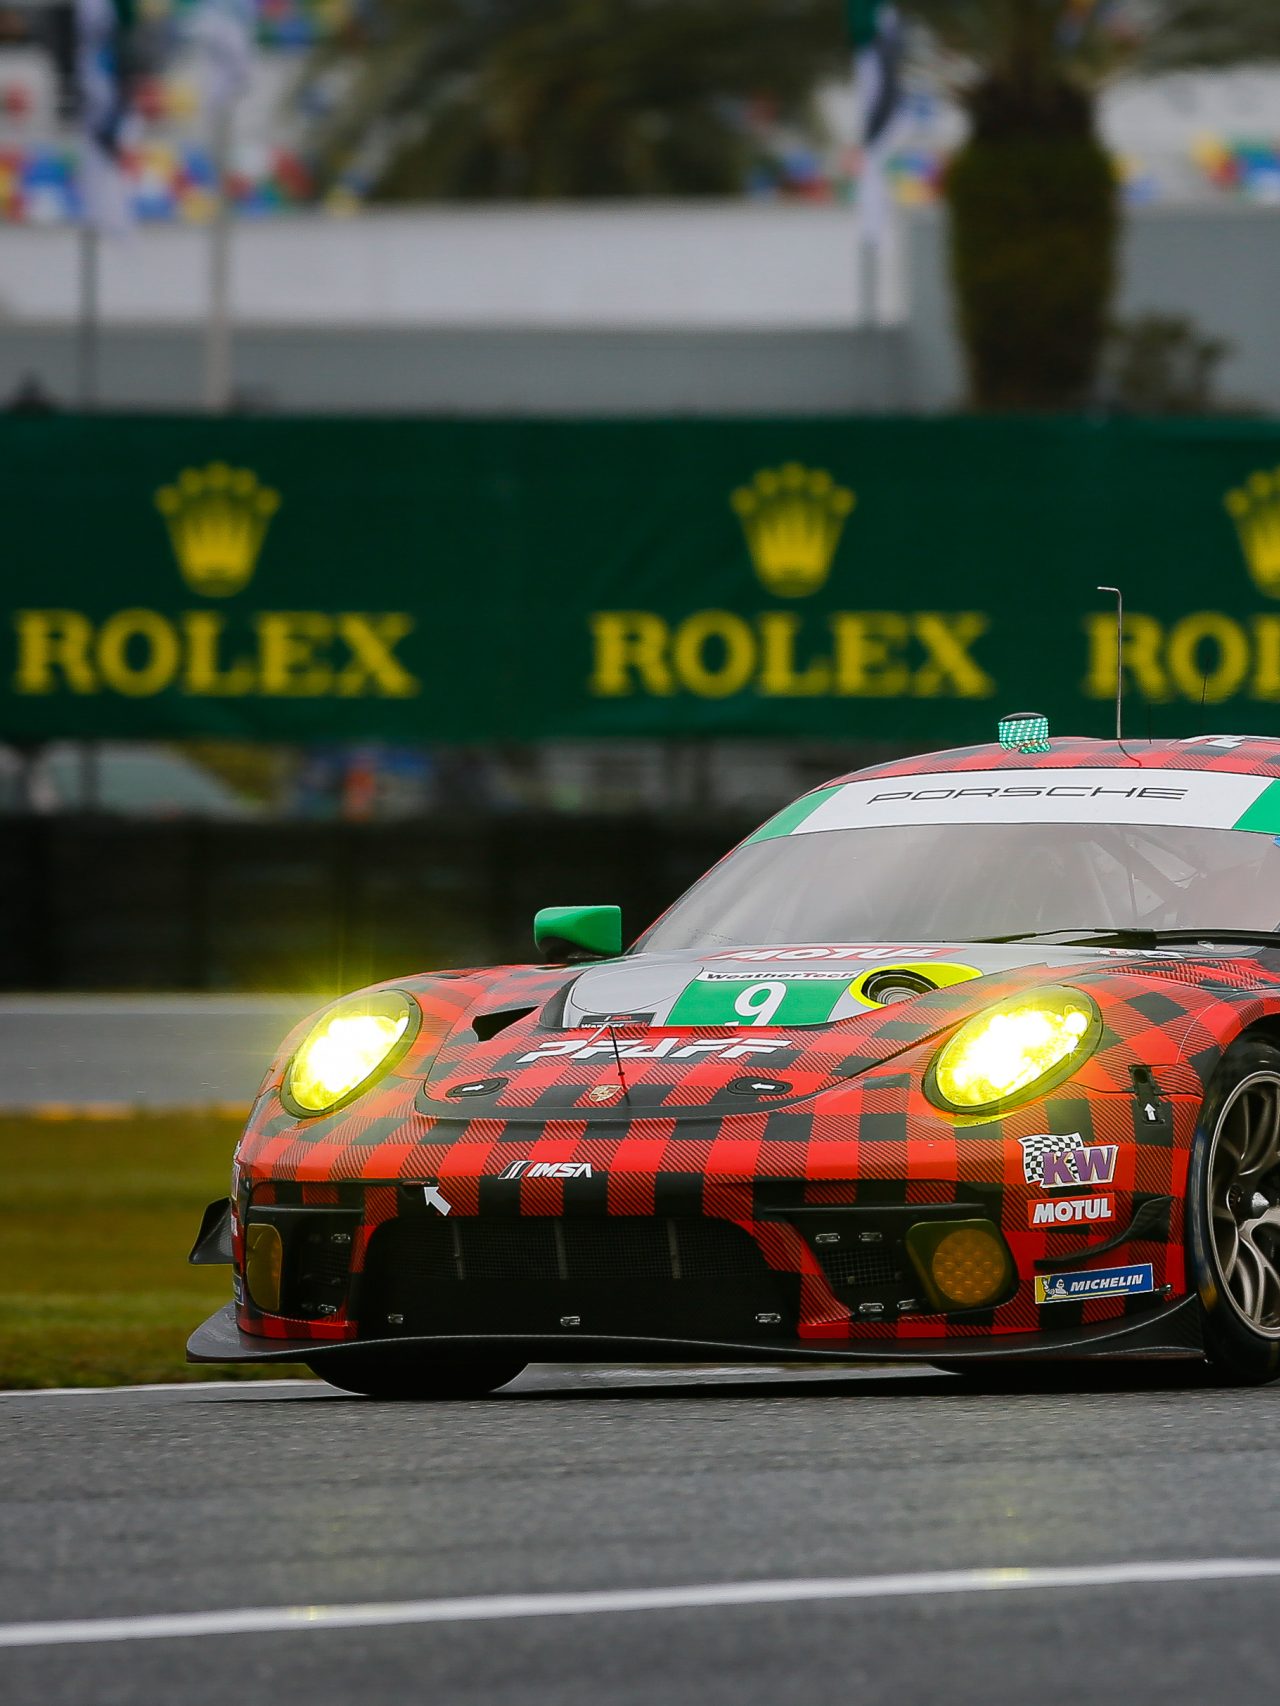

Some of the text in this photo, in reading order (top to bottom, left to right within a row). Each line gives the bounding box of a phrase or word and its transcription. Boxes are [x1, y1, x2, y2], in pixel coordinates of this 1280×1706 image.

[14, 608, 420, 699] ROLEX
[589, 609, 995, 699] ROLEX
[867, 785, 1188, 805] PORSCHE
[708, 948, 942, 962] MOTUL
[706, 971, 853, 981] WeatherTech
[724, 981, 787, 1027] 9
[527, 1161, 593, 1179] IMSA
[1042, 1149, 1115, 1186] KW
[1033, 1197, 1112, 1224] MOTUL
[1070, 1273, 1144, 1293] MICHELIN
